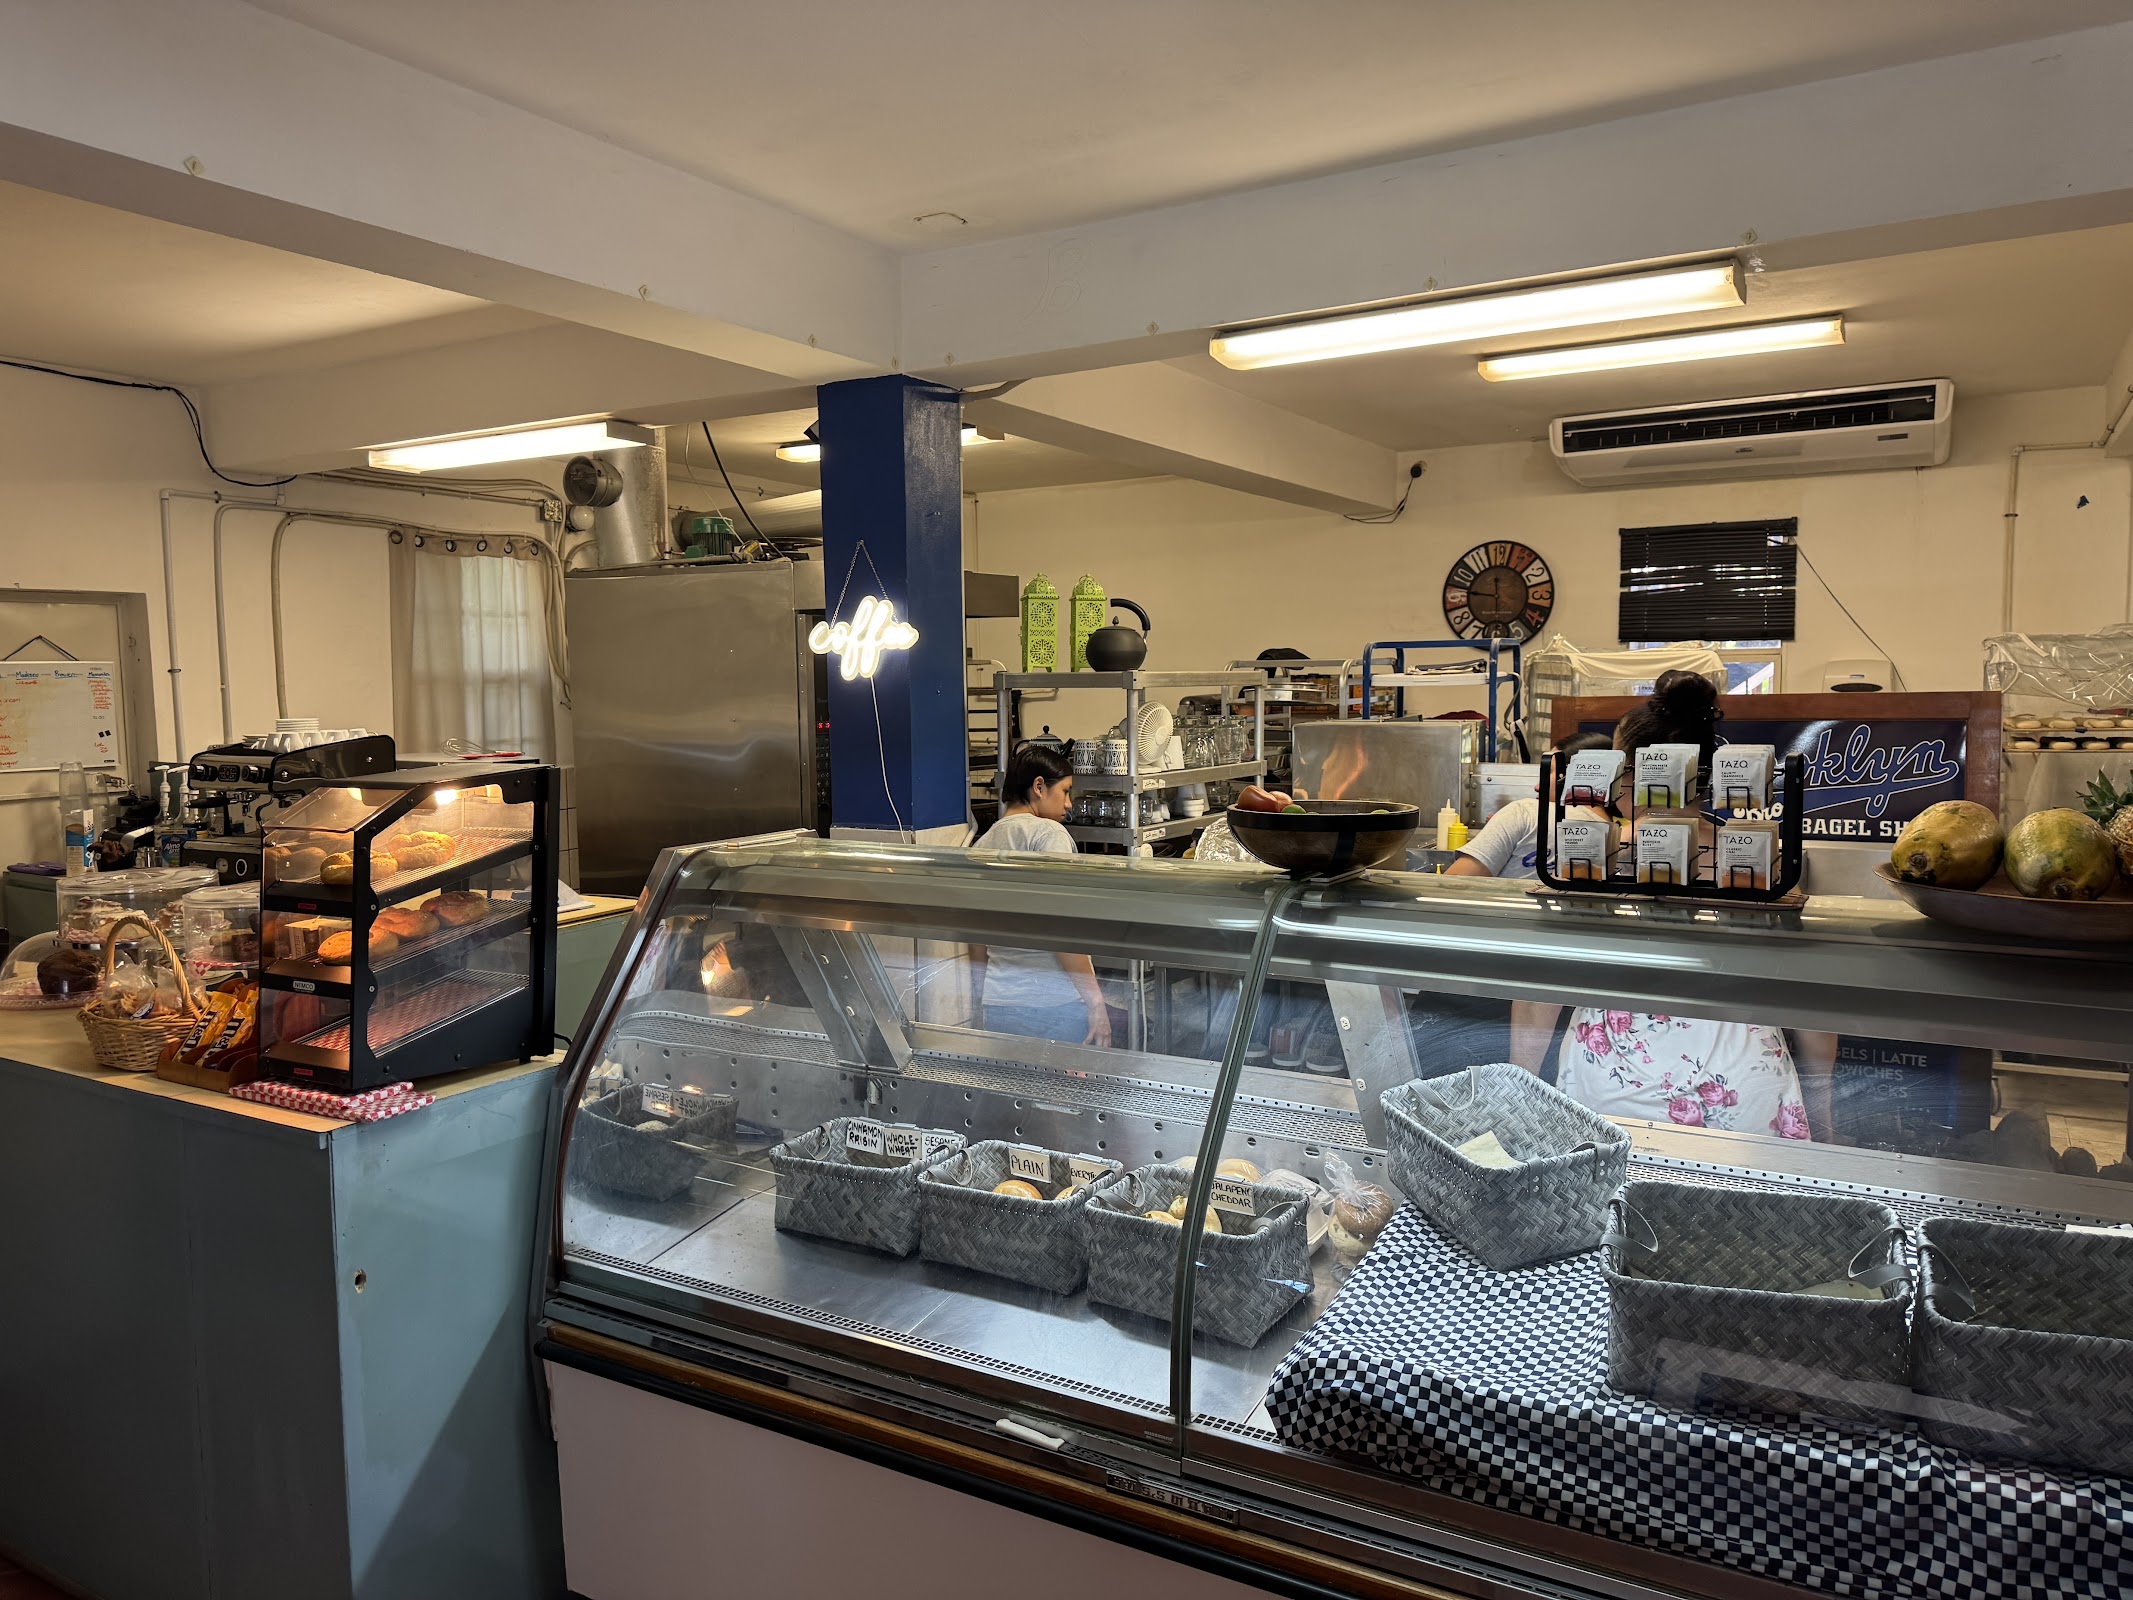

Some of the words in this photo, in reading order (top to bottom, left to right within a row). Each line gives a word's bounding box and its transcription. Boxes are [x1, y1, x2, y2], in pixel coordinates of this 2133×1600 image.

[1493, 545, 1507, 566] 12
[1453, 567, 1475, 587] 10
[1525, 566, 1545, 583] 2
[1531, 590, 1552, 601] 3
[1453, 610, 1471, 625] 8
[1508, 620, 1525, 640] 5
[1640, 752, 1668, 761] TAZO
[1719, 759, 1748, 769] TAZO
[1562, 827, 1588, 836] TAZO
[1640, 829, 1668, 838] TAZO
[1802, 817, 1872, 837] BAGEL
[1879, 820, 1911, 837] SH
[1723, 835, 1753, 845] TAZO
[1881, 1051, 1928, 1068] LATTE
[1834, 1062, 1904, 1081] DWICHES
[887, 1144, 918, 1157] WHEAT
[1010, 1154, 1044, 1177] PLAIN
[1070, 1167, 1097, 1181] EVERYT
[1210, 1191, 1253, 1209] CHEDDAR
